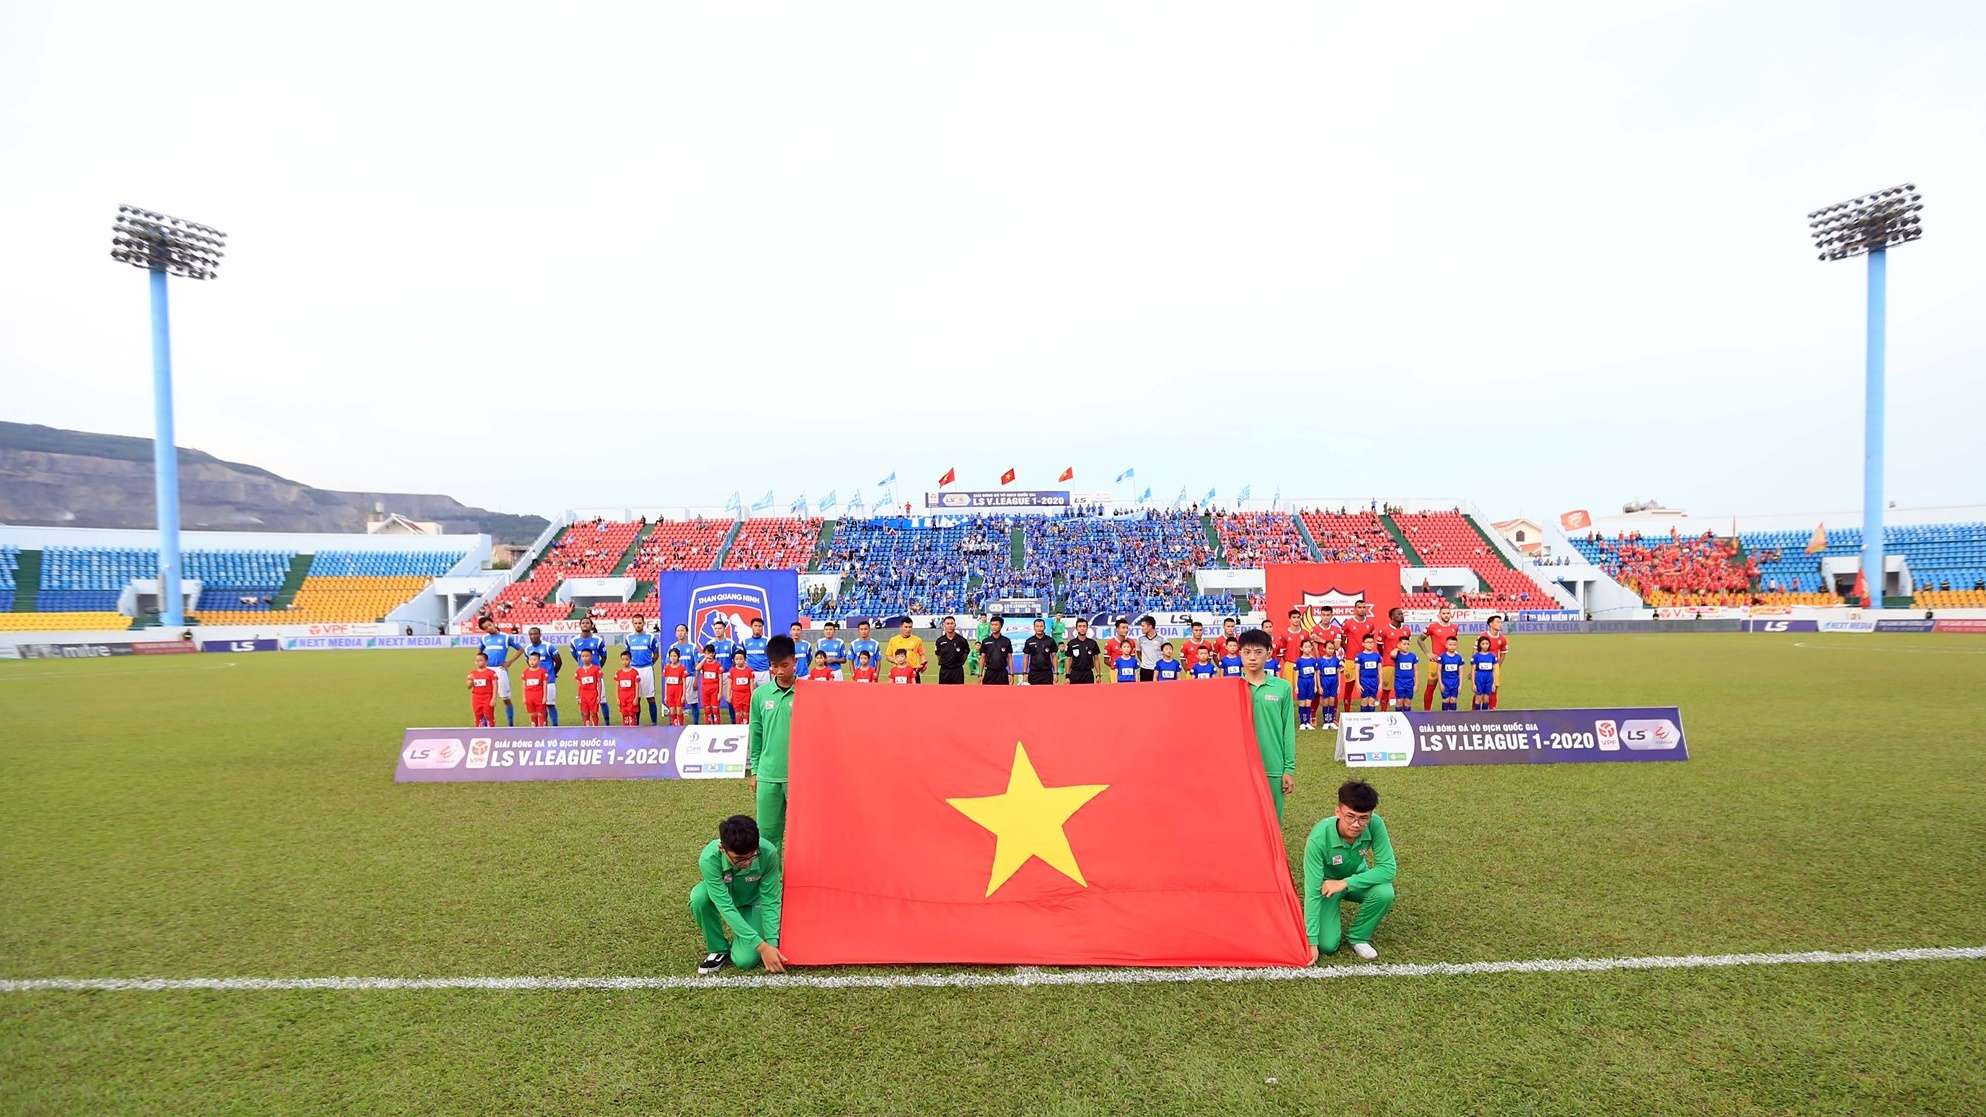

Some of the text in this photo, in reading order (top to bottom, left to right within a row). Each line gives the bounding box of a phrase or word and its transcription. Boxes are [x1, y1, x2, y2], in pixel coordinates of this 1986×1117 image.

[973, 496, 1064, 506] LS V.LEAGUE 1-2020
[322, 624, 349, 634] VPF
[1154, 627, 1178, 636] EDIA
[1203, 627, 1222, 636] EXT
[1519, 622, 1580, 632] NEXT MEDIA
[1764, 621, 1790, 632] LS
[231, 641, 255, 651] LS
[299, 637, 363, 648] NEXT MEDIA
[378, 636, 442, 647] NEXT MEDIA
[62, 644, 112, 657] mitre
[1470, 723, 1481, 732] VÔ
[1525, 723, 1539, 731] GIA
[1345, 726, 1375, 742] LS
[1627, 730, 1646, 741] LS
[547, 739, 558, 747] VÔ
[707, 737, 740, 753] LS
[1419, 734, 1443, 752] LS
[1445, 733, 1529, 751] V.LEAGUE
[1532, 732, 1595, 750] 1-2020
[410, 749, 430, 760] LS
[490, 748, 670, 767] LS V.LEAGUE 1-2020
